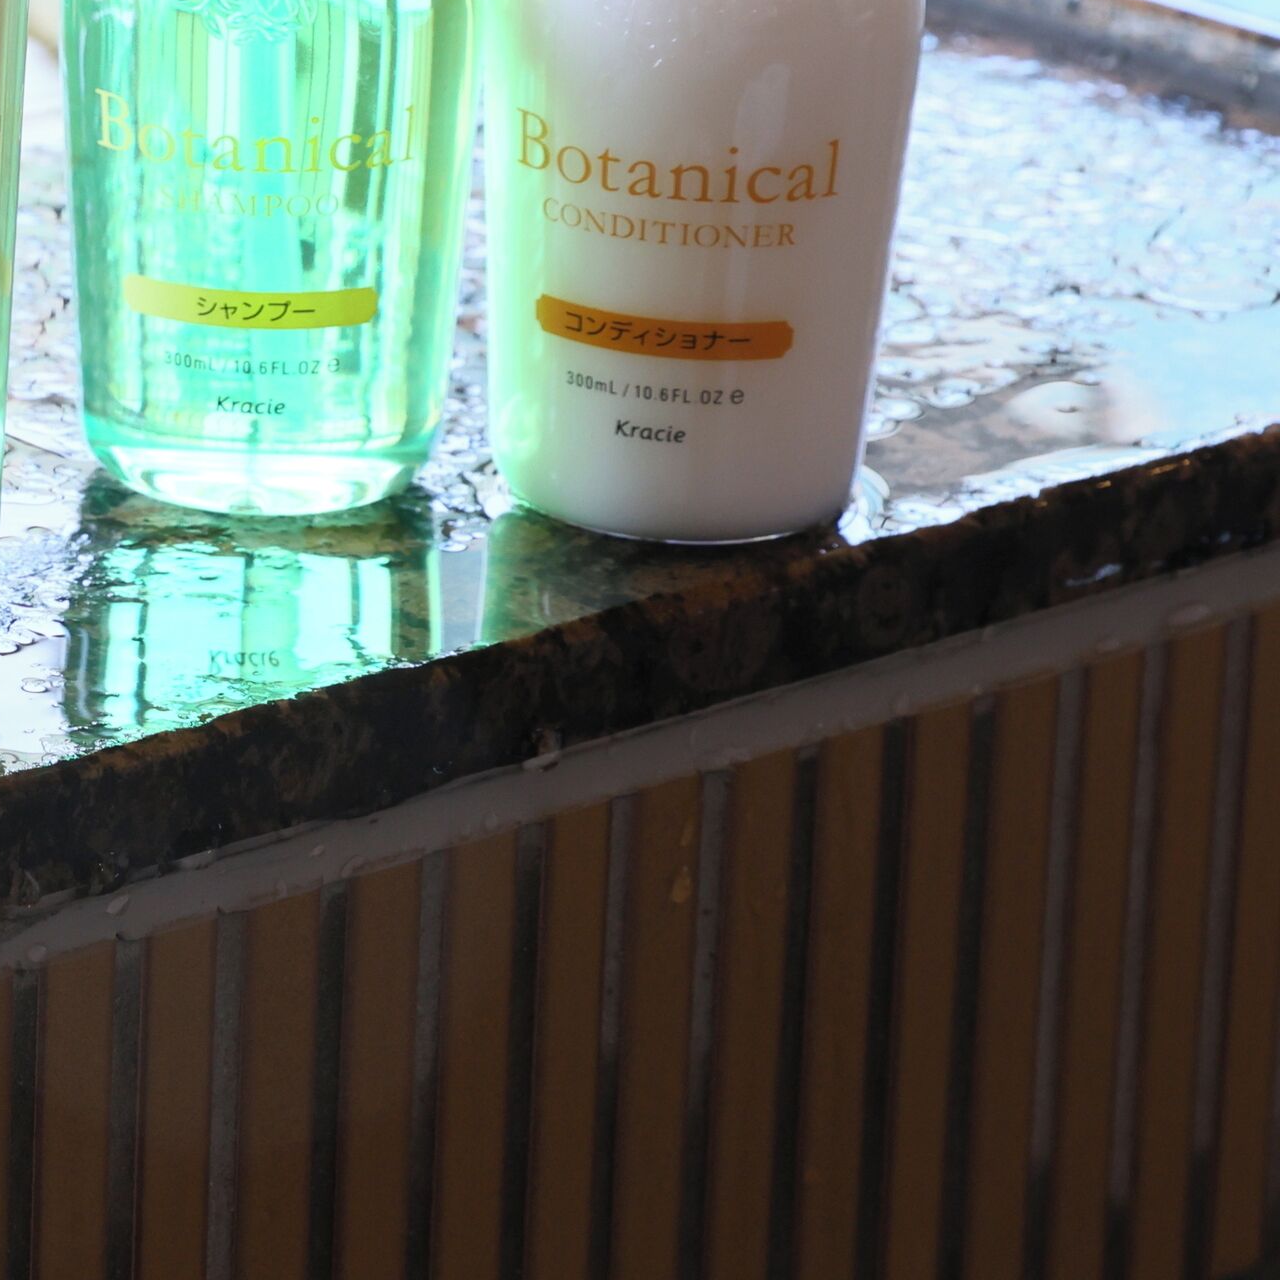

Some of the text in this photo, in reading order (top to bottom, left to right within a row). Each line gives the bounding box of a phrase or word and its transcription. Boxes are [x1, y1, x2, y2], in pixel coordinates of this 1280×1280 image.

[95, 87, 416, 173] Botanical
[516, 107, 840, 204] Botanical
[160, 183, 339, 217] SHAMPOO
[543, 197, 796, 248] CONDITIONER
[197, 297, 316, 322] シャンプー
[565, 311, 752, 351] コンディショナー
[566, 370, 618, 396] 300mL
[216, 395, 286, 416] Kracie
[615, 419, 687, 444] Kracie
